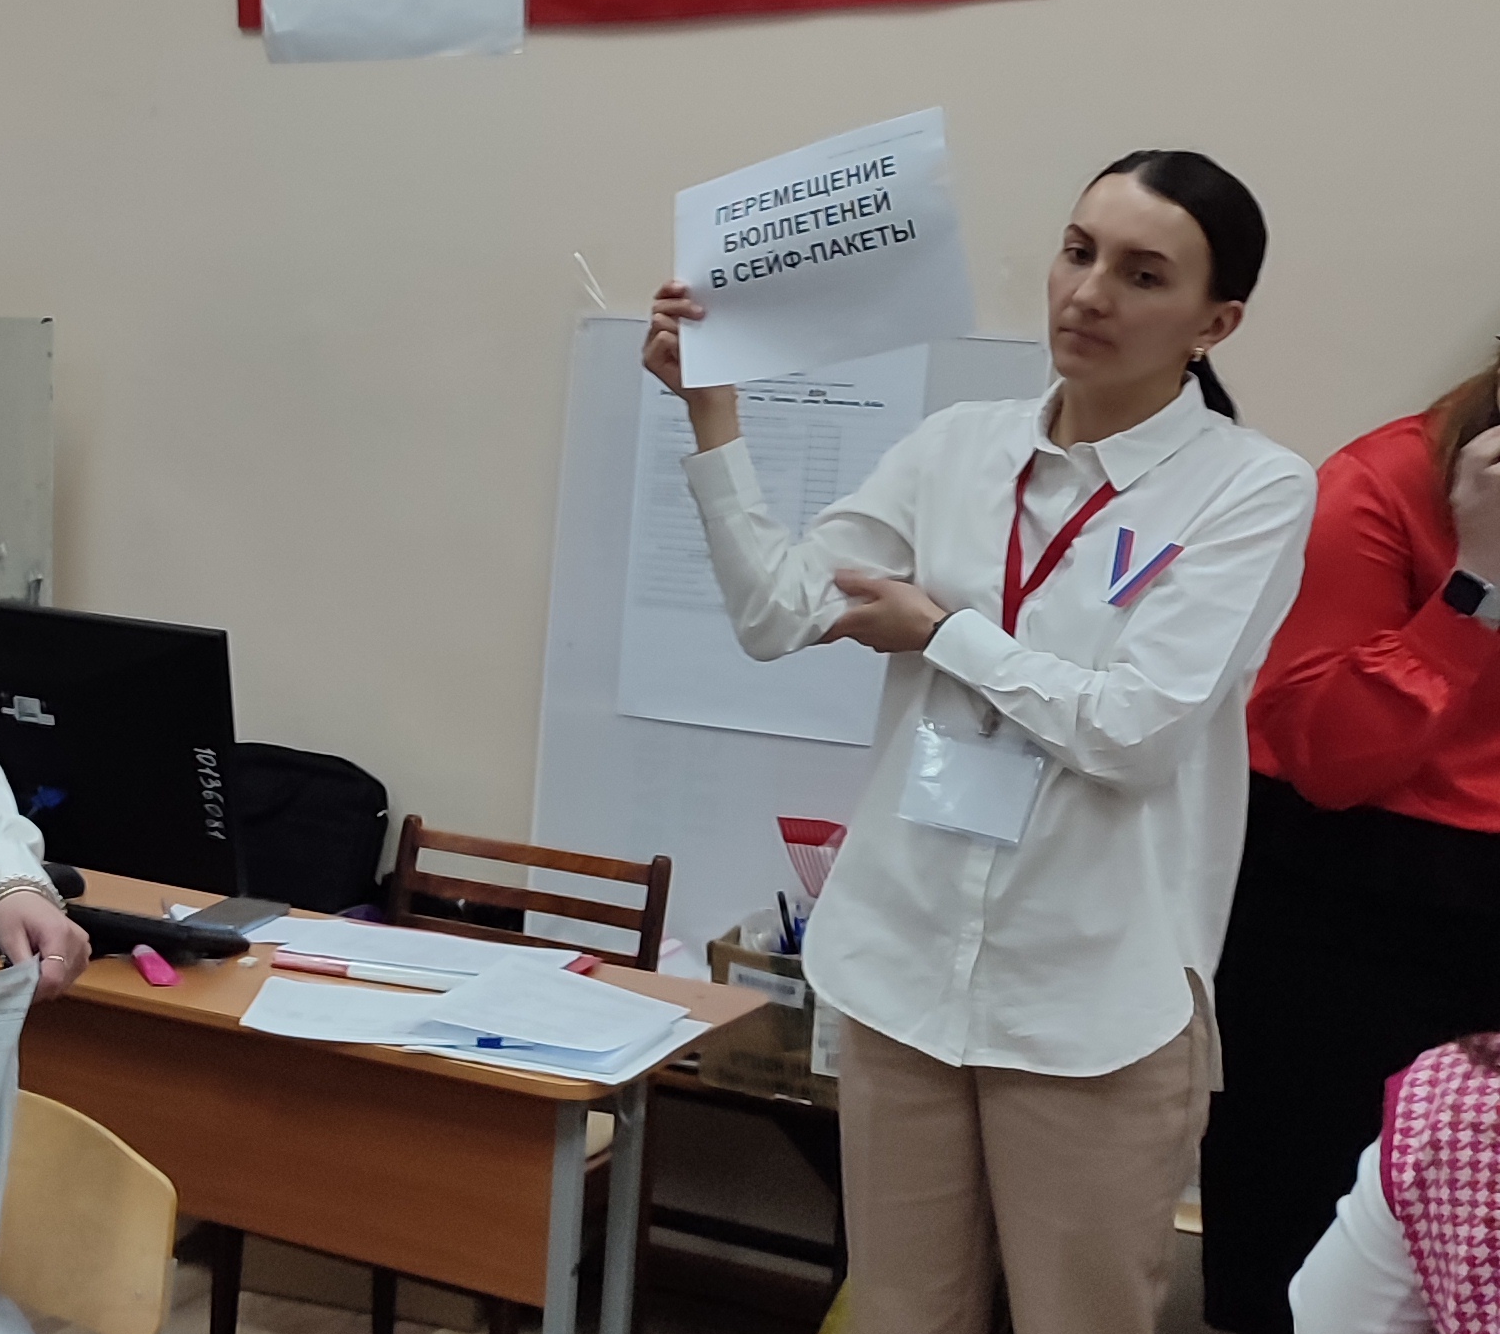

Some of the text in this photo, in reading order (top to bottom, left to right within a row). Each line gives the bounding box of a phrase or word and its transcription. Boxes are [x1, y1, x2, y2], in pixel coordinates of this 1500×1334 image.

[714, 155, 897, 225] ПЕРЕМЕЩЕНИЕ
[723, 186, 892, 253] БЮЛЛЕТЕНЕЙ
[710, 219, 916, 289] В СЕЙФ-ПАКЕТЫ
[193, 747, 227, 840] 10136081
